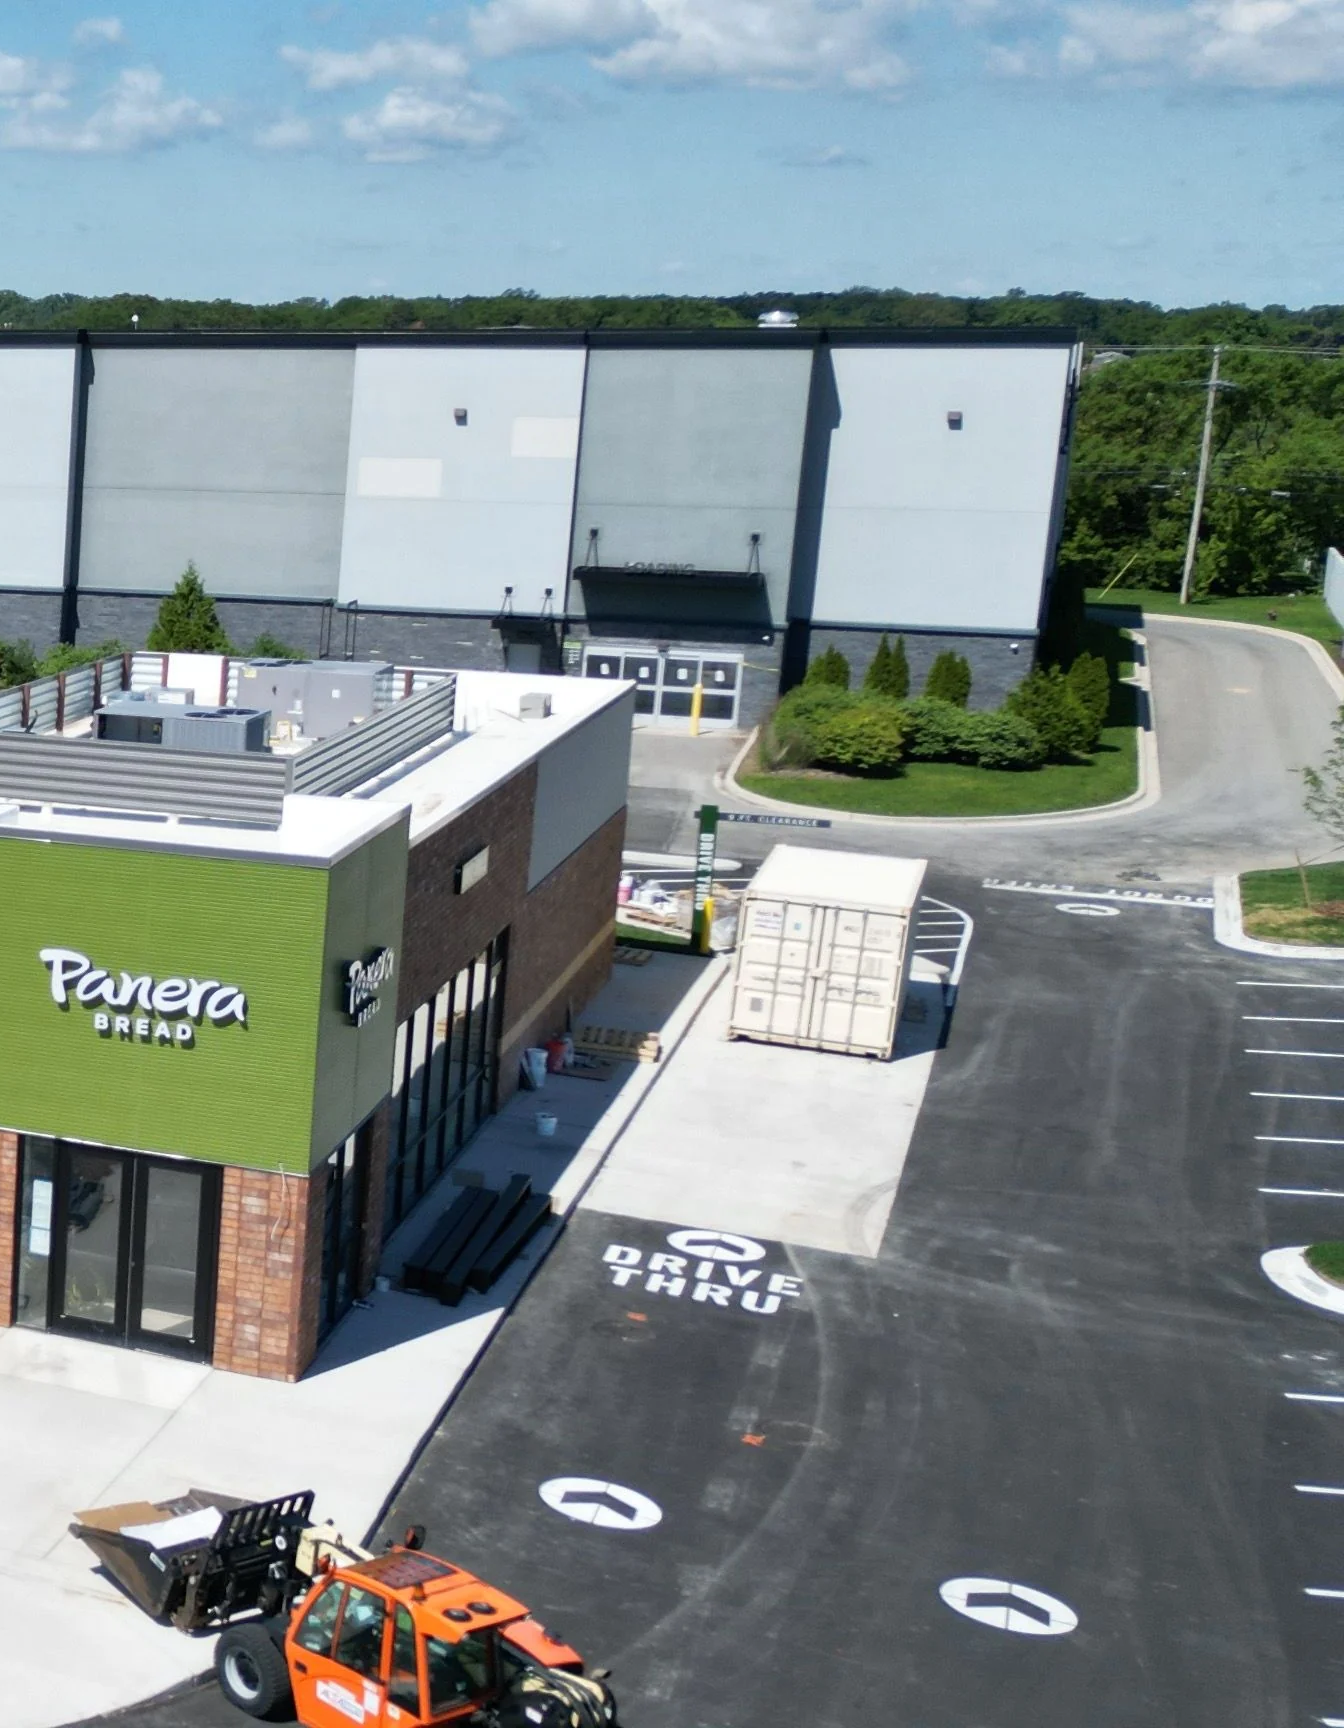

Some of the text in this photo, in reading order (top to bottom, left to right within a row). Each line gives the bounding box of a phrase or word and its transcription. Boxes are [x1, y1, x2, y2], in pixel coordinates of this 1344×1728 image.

[624, 561, 696, 576] LOADING
[758, 815, 818, 827] CLEARANCE
[698, 833, 714, 872] DRIVE
[39, 948, 246, 1022] Panera
[94, 1012, 193, 1041] BREAD
[602, 1244, 805, 1298] DRIVE
[609, 1265, 782, 1315] THRU
